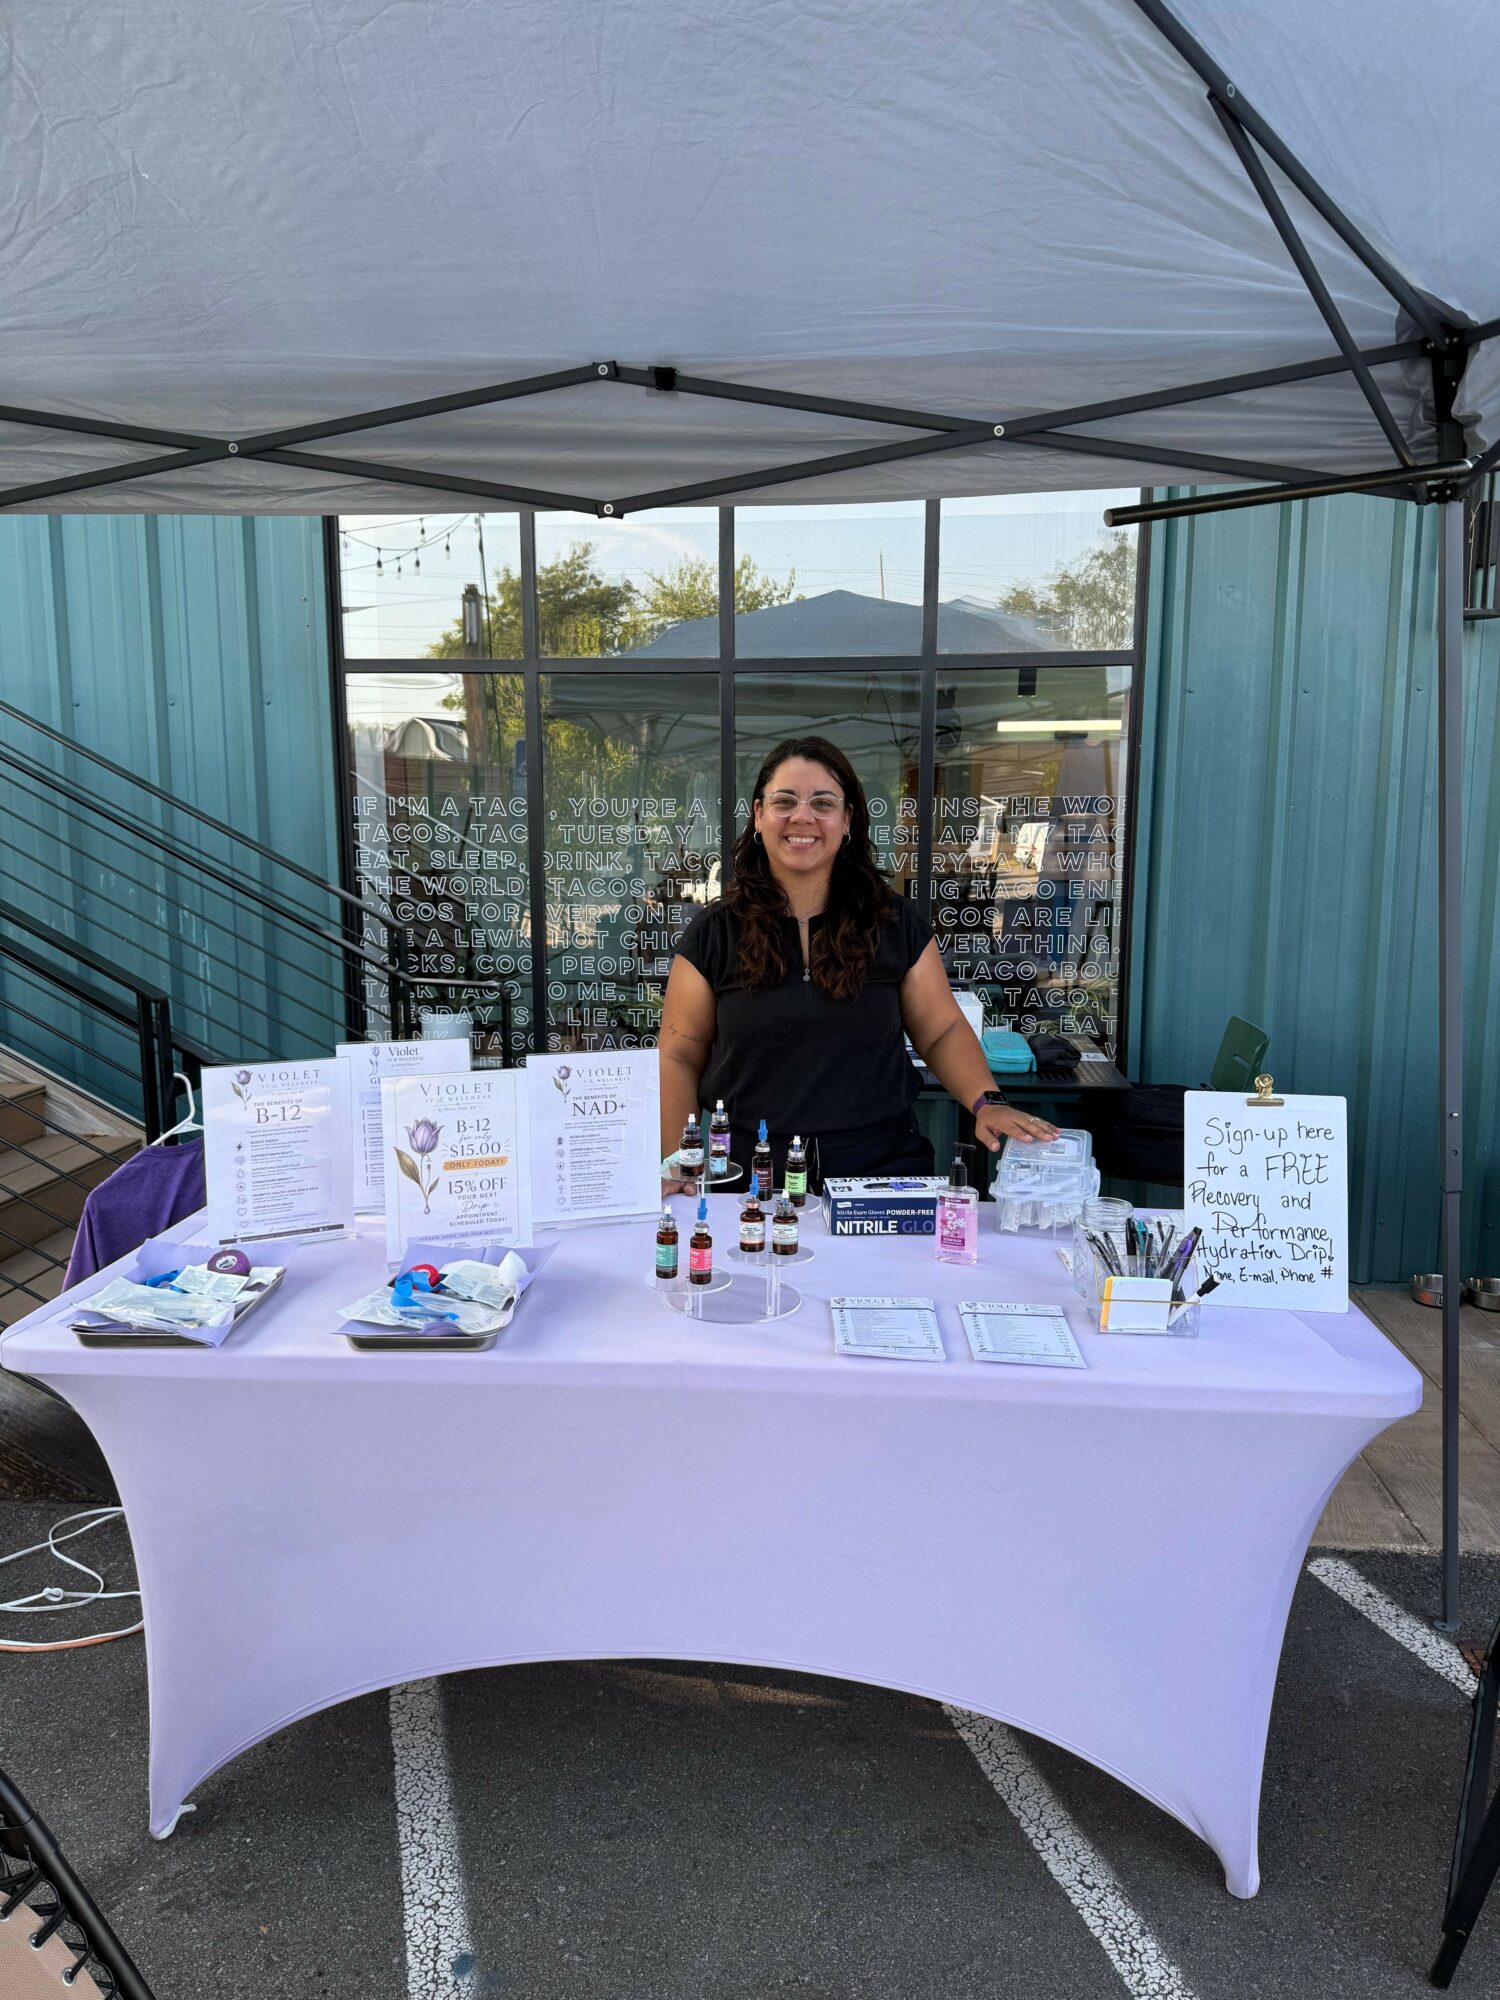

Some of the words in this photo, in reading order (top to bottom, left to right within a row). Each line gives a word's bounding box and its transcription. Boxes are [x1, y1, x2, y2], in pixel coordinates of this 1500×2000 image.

[353, 797, 377, 816] IF
[389, 797, 429, 816] I'M
[441, 797, 459, 816] A
[569, 798, 677, 818] YOU'RE
[688, 798, 706, 818] A
[900, 797, 979, 818] RNS
[992, 796, 1050, 816] THE
[354, 823, 460, 843] TACOS.
[471, 824, 528, 843] TAC
[559, 825, 694, 844] TUESDAY
[938, 825, 998, 845] ARE
[356, 850, 419, 872] EAT,
[430, 850, 526, 873] SLEEP,
[543, 851, 633, 874] DRINK,
[356, 876, 411, 895] THE
[421, 877, 530, 896] WORLD
[549, 877, 656, 898] TACOS.
[971, 880, 1056, 900] TACO
[465, 903, 519, 922] FOR
[546, 903, 692, 924] VERYONE.
[931, 907, 1000, 927] COS
[1012, 907, 1072, 927] ARE
[425, 929, 443, 947] A
[455, 929, 532, 948] LEWK
[552, 930, 609, 949] HOT
[934, 934, 1121, 954] VERYTHING.
[476, 955, 551, 975] COO
[562, 956, 670, 976] PEOPLE
[954, 960, 1037, 981] TACO
[362, 979, 433, 999] TAK
[578, 983, 626, 1001] ME.
[637, 983, 662, 1001] IF
[976, 988, 992, 1007] A
[1004, 988, 1099, 1008] TACO.
[567, 1008, 618, 1027] LIE.
[983, 1014, 1047, 1034] NTS.
[388, 1046, 419, 1057] Violet
[258, 1069, 321, 1082] VIOLET
[577, 1066, 633, 1078] VIOLET
[420, 1082, 494, 1096] VIOLET
[255, 1104, 302, 1124] B-12
[572, 1100, 627, 1117] NAD+
[457, 1118, 491, 1133] B-12
[475, 1131, 494, 1142] only
[1203, 1117, 1288, 1155] Sign-up
[1297, 1121, 1334, 1141] here
[450, 1142, 501, 1159] $15.00
[450, 1161, 470, 1169] ONLY
[1196, 1151, 1229, 1177] for
[1240, 1164, 1249, 1178] a
[1265, 1151, 1329, 1185] FREE
[448, 1180, 477, 1194] 15%
[480, 1177, 508, 1191] OFF
[1188, 1180, 1260, 1226] Recovery
[1280, 1191, 1311, 1211] and
[449, 1218, 485, 1227] SCHEDULED
[456, 1211, 498, 1220] APPOINTMENT
[837, 1221, 898, 1234] NITRILE
[1211, 1211, 1330, 1241] Performance
[1196, 1235, 1282, 1267] Hydration
[1286, 1238, 1334, 1265] Drip!
[1280, 1267, 1316, 1283] Phone
[1320, 1265, 1334, 1280] #
